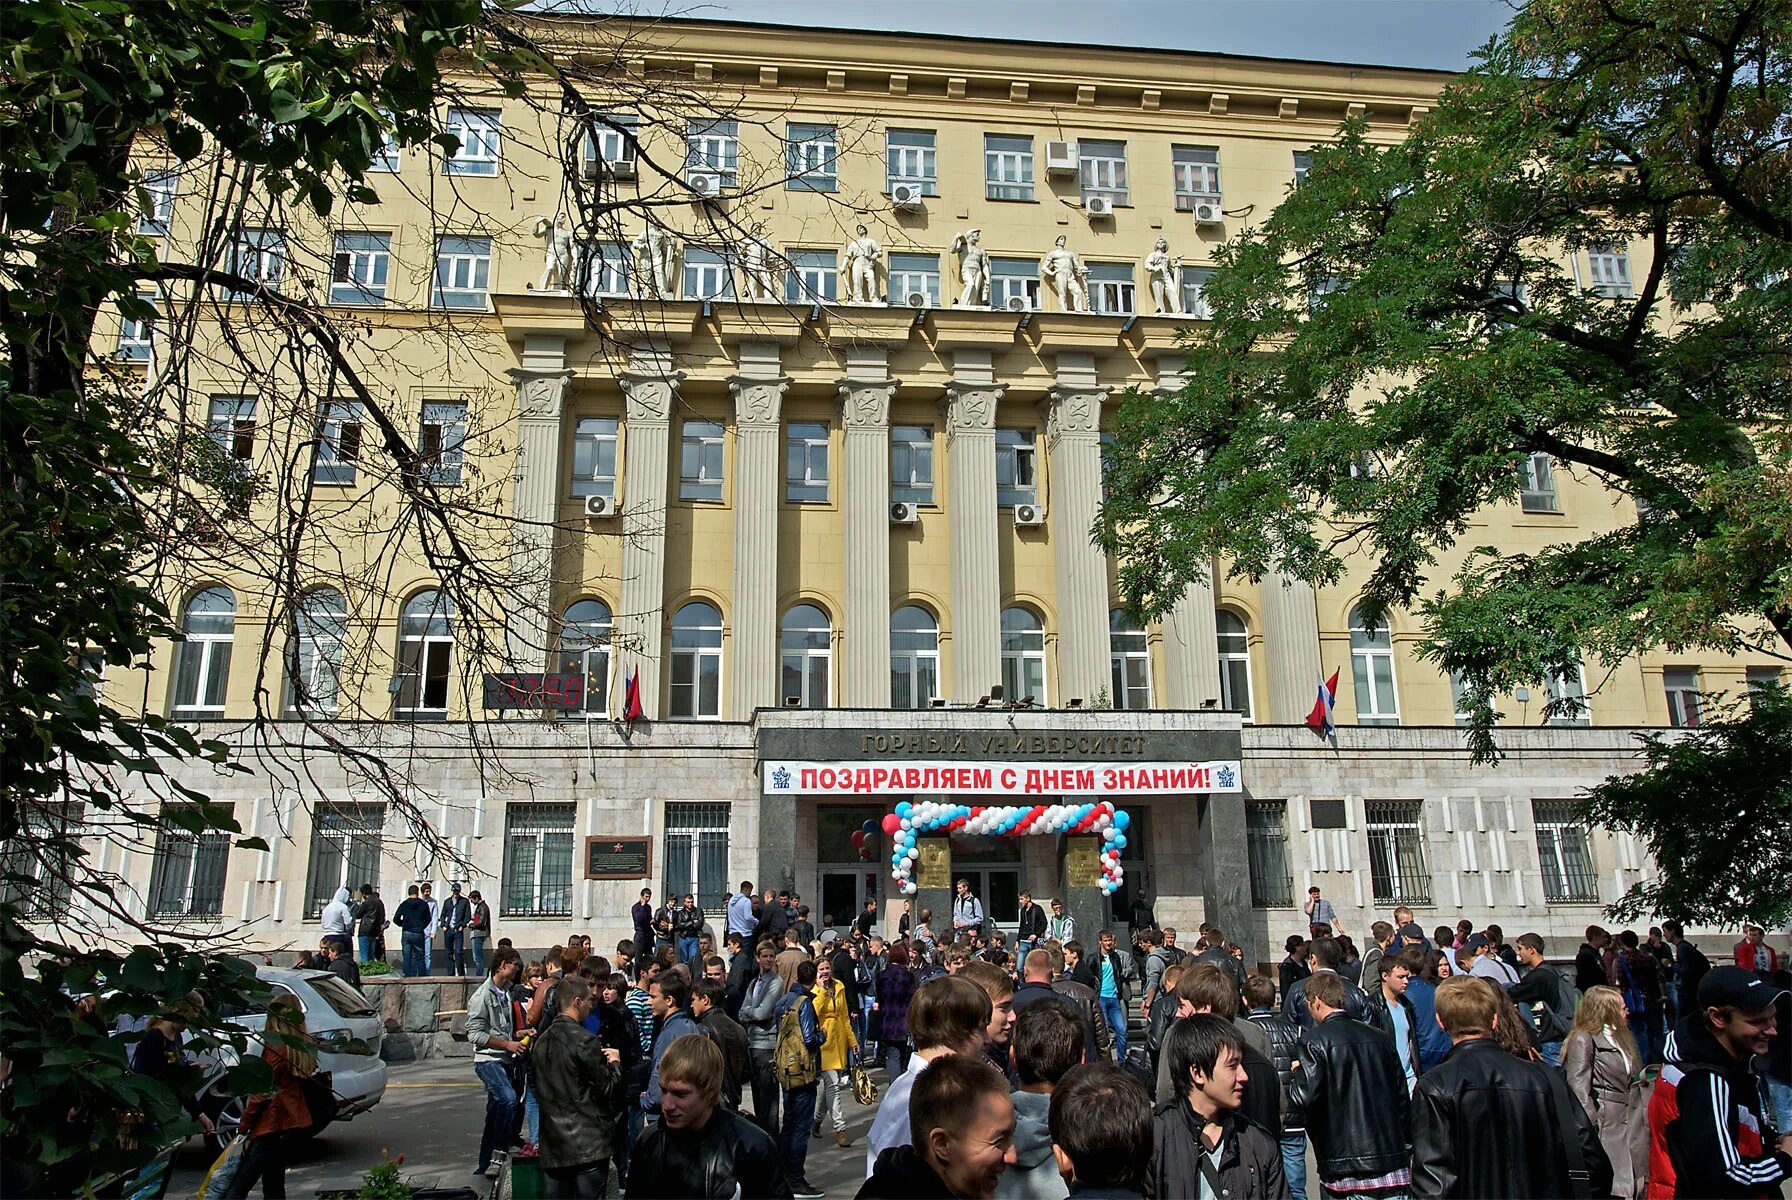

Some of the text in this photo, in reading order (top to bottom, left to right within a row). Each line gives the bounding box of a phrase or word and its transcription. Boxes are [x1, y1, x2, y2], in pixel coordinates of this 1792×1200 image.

[861, 733, 1146, 755] ГОРНЫЙ УНИВЕРСИТЕТ
[800, 762, 1212, 794] ПОЗДРАВЛЯЕМ С ДНЕМ ЗНАНИЙ!
